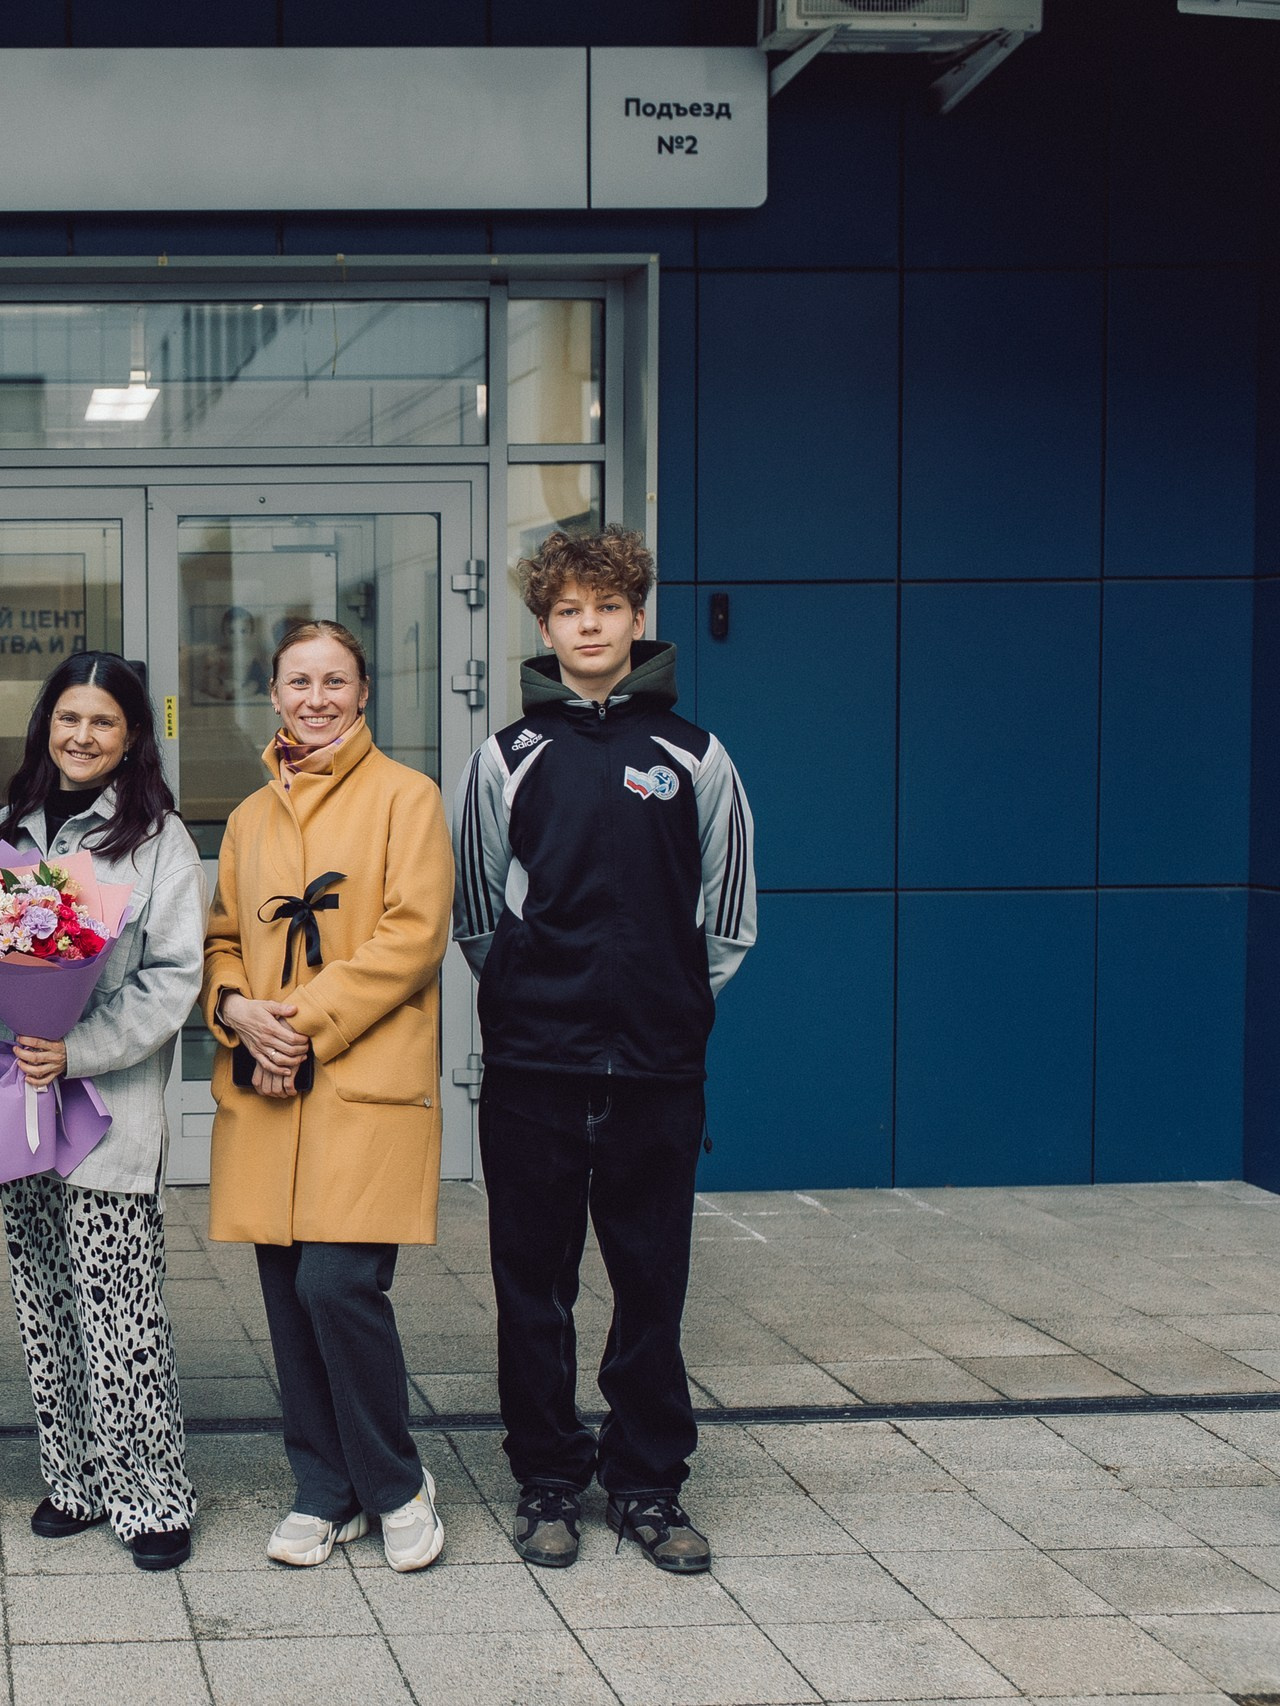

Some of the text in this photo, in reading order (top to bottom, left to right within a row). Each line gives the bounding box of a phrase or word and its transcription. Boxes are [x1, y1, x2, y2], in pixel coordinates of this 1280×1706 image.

[624, 97, 733, 121] Подъезд
[657, 135, 699, 155] №2
[21, 609, 85, 631] ЦЕНТ
[511, 733, 544, 751] adidas
